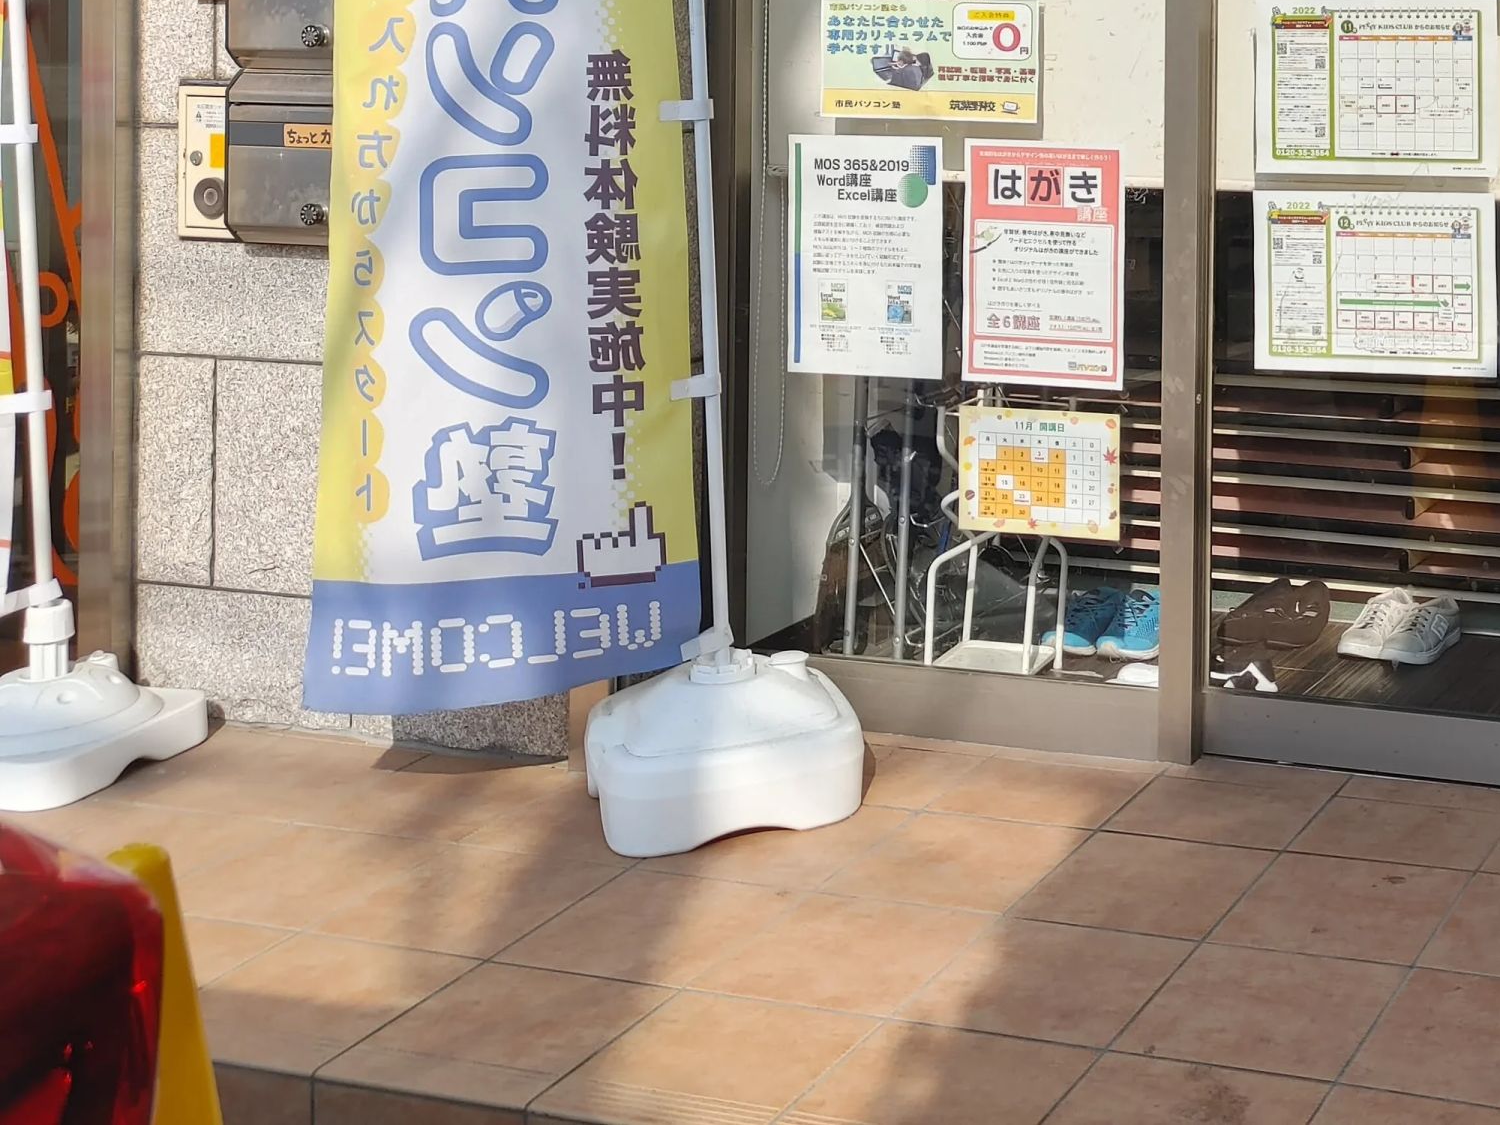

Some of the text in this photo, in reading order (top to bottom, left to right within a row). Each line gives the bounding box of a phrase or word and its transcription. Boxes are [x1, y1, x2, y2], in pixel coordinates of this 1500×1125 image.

[827, 15, 945, 28] あなたに合わせた
[827, 29, 952, 43] 専用カリキュラムで
[834, 100, 902, 109] 市民パソコン塾
[814, 158, 911, 173] MOS 365&2019
[816, 173, 872, 188] Word講座
[993, 169, 1098, 203] はがき
[837, 188, 898, 202] Excel講座
[1286, 202, 1310, 210] 2022
[1076, 205, 1108, 224] 講座
[1015, 422, 1065, 432] 11月 開講日
